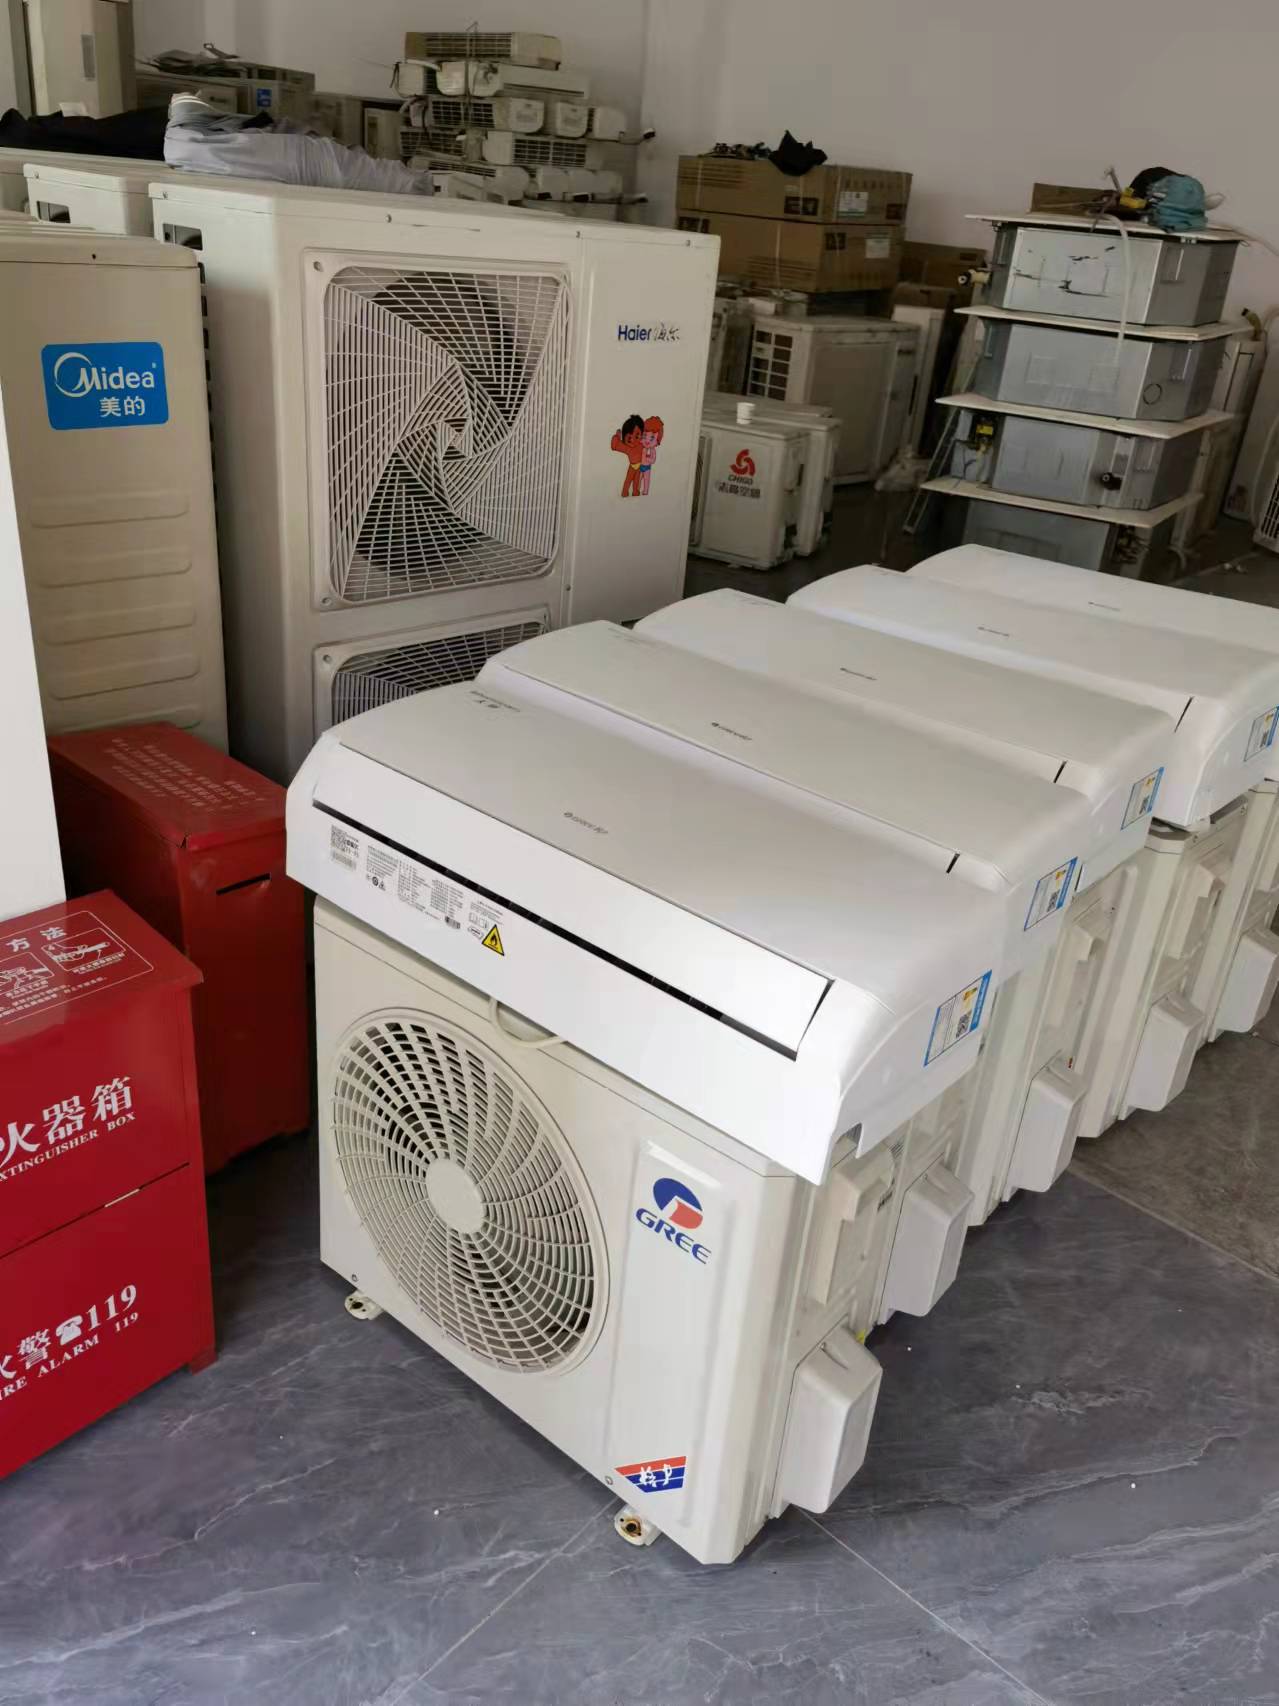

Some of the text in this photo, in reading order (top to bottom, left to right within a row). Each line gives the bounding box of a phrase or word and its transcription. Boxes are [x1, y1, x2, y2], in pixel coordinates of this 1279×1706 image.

[617, 324, 652, 341] Haier
[68, 364, 155, 392] Midea
[99, 396, 146, 418] 美的
[0, 1076, 133, 1169] 火器箱
[107, 1112, 136, 1132] BOX
[635, 1207, 712, 1265] GREE
[86, 1284, 137, 1332] 119
[37, 1334, 100, 1378] ALARM
[114, 1312, 139, 1333] 119
